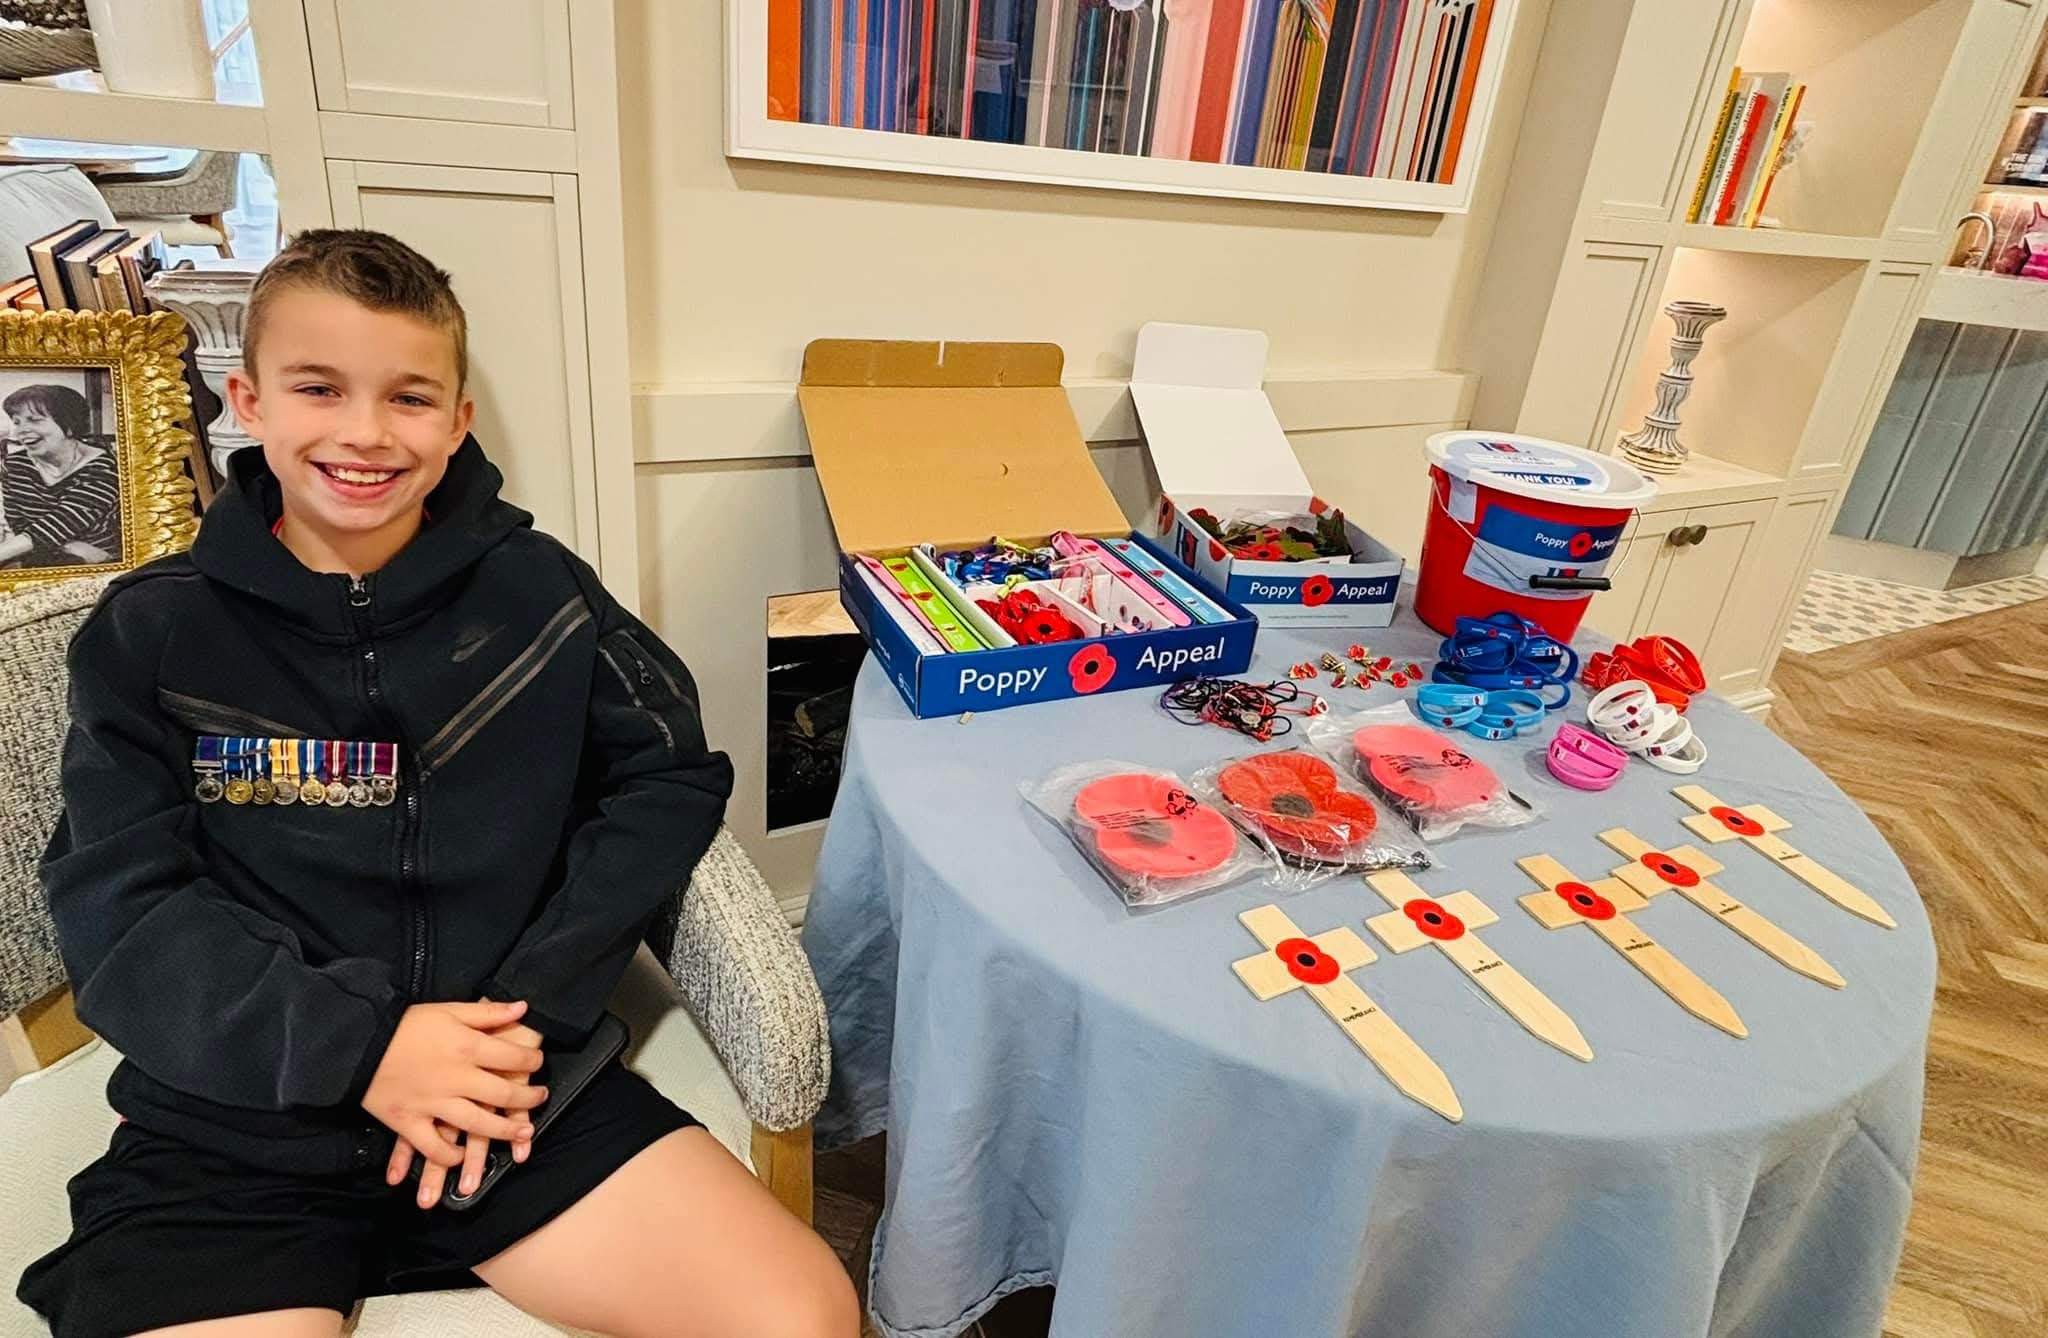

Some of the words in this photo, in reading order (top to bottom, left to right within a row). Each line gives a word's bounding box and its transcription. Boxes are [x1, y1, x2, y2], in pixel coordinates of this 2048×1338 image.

[1535, 533, 1568, 549] Poppy
[1249, 581, 1297, 600] Poppy
[1336, 582, 1388, 600] Appeal
[959, 666, 1048, 696] Poppy
[1136, 636, 1226, 674] Appeal
